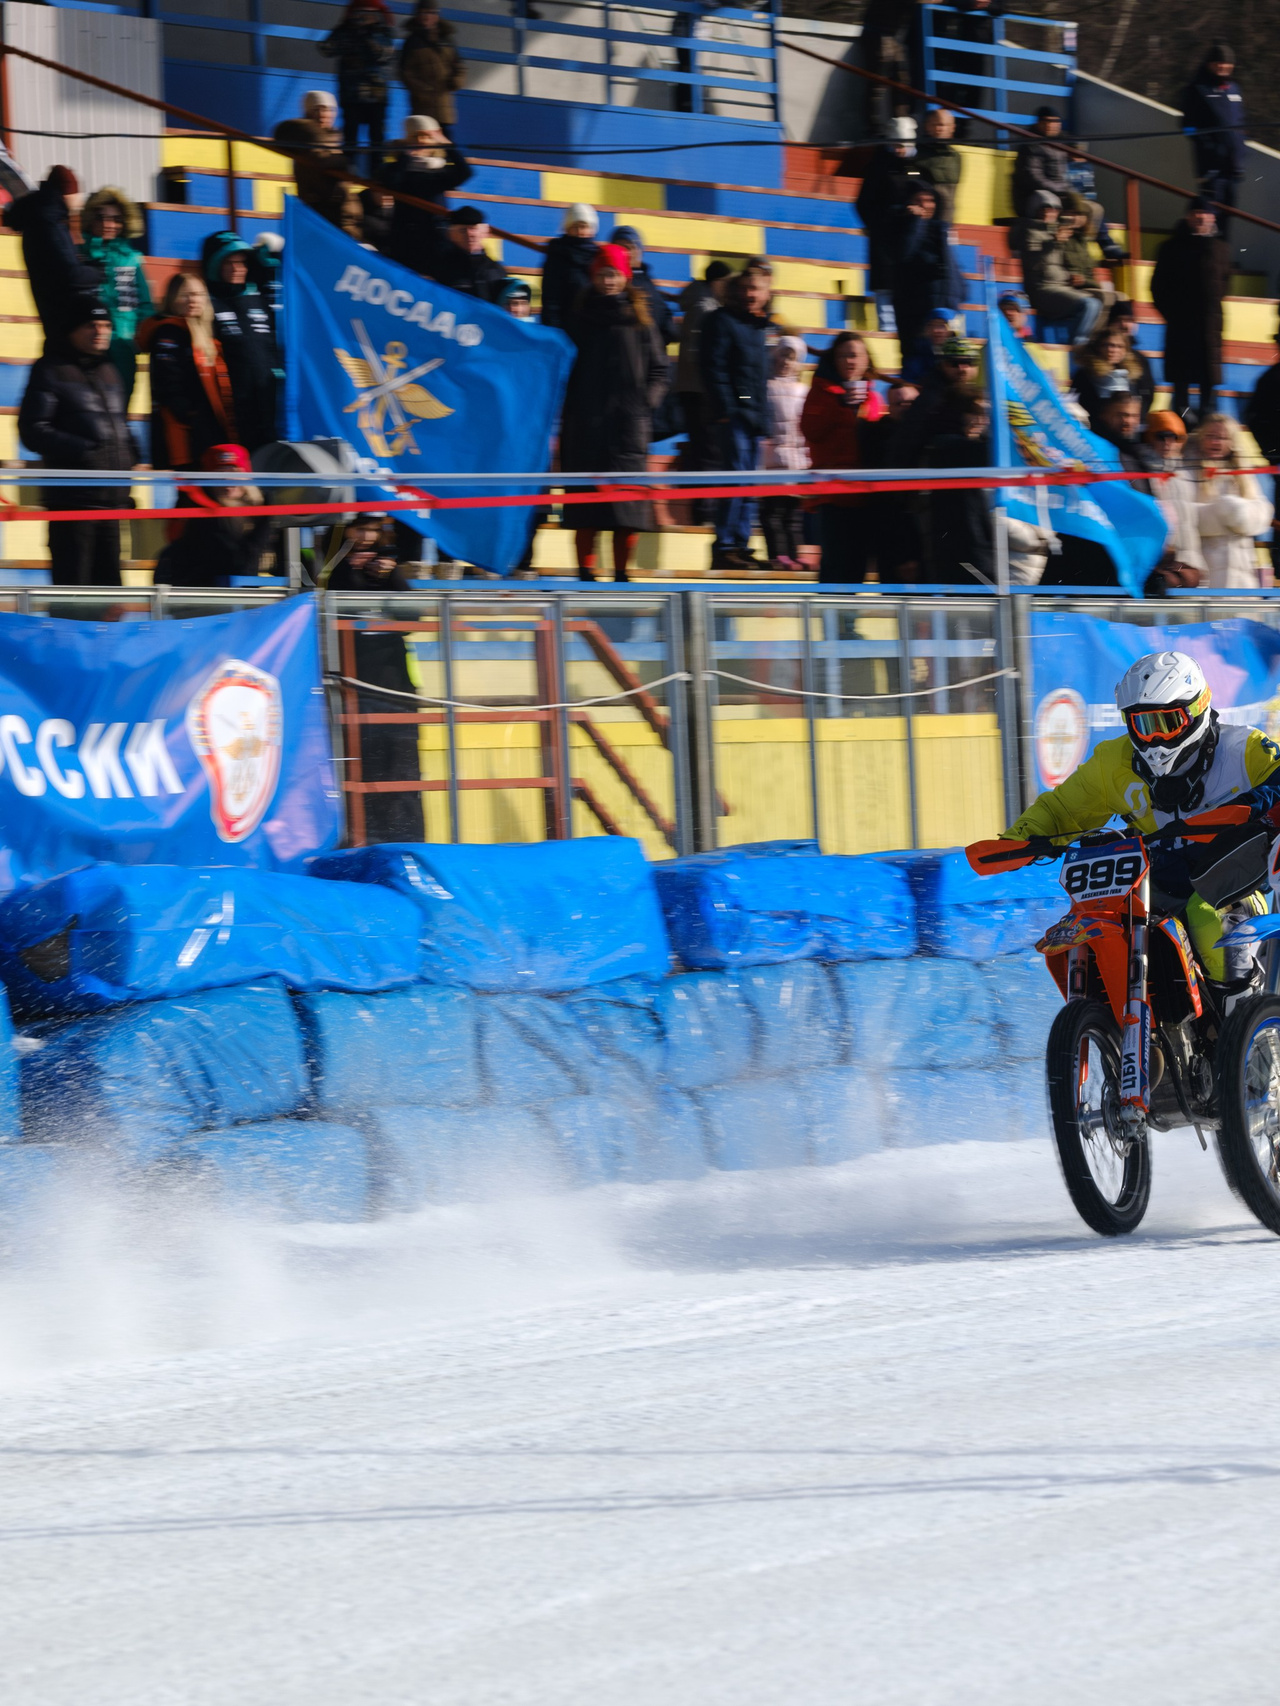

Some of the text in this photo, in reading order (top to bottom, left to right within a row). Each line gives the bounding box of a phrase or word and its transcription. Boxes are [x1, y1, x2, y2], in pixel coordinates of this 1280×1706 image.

[334, 264, 484, 347] ДОСААФ
[0, 714, 187, 799] ССИИ
[1065, 855, 1142, 895] 899
[1122, 1052, 1137, 1090] ЦБИ
